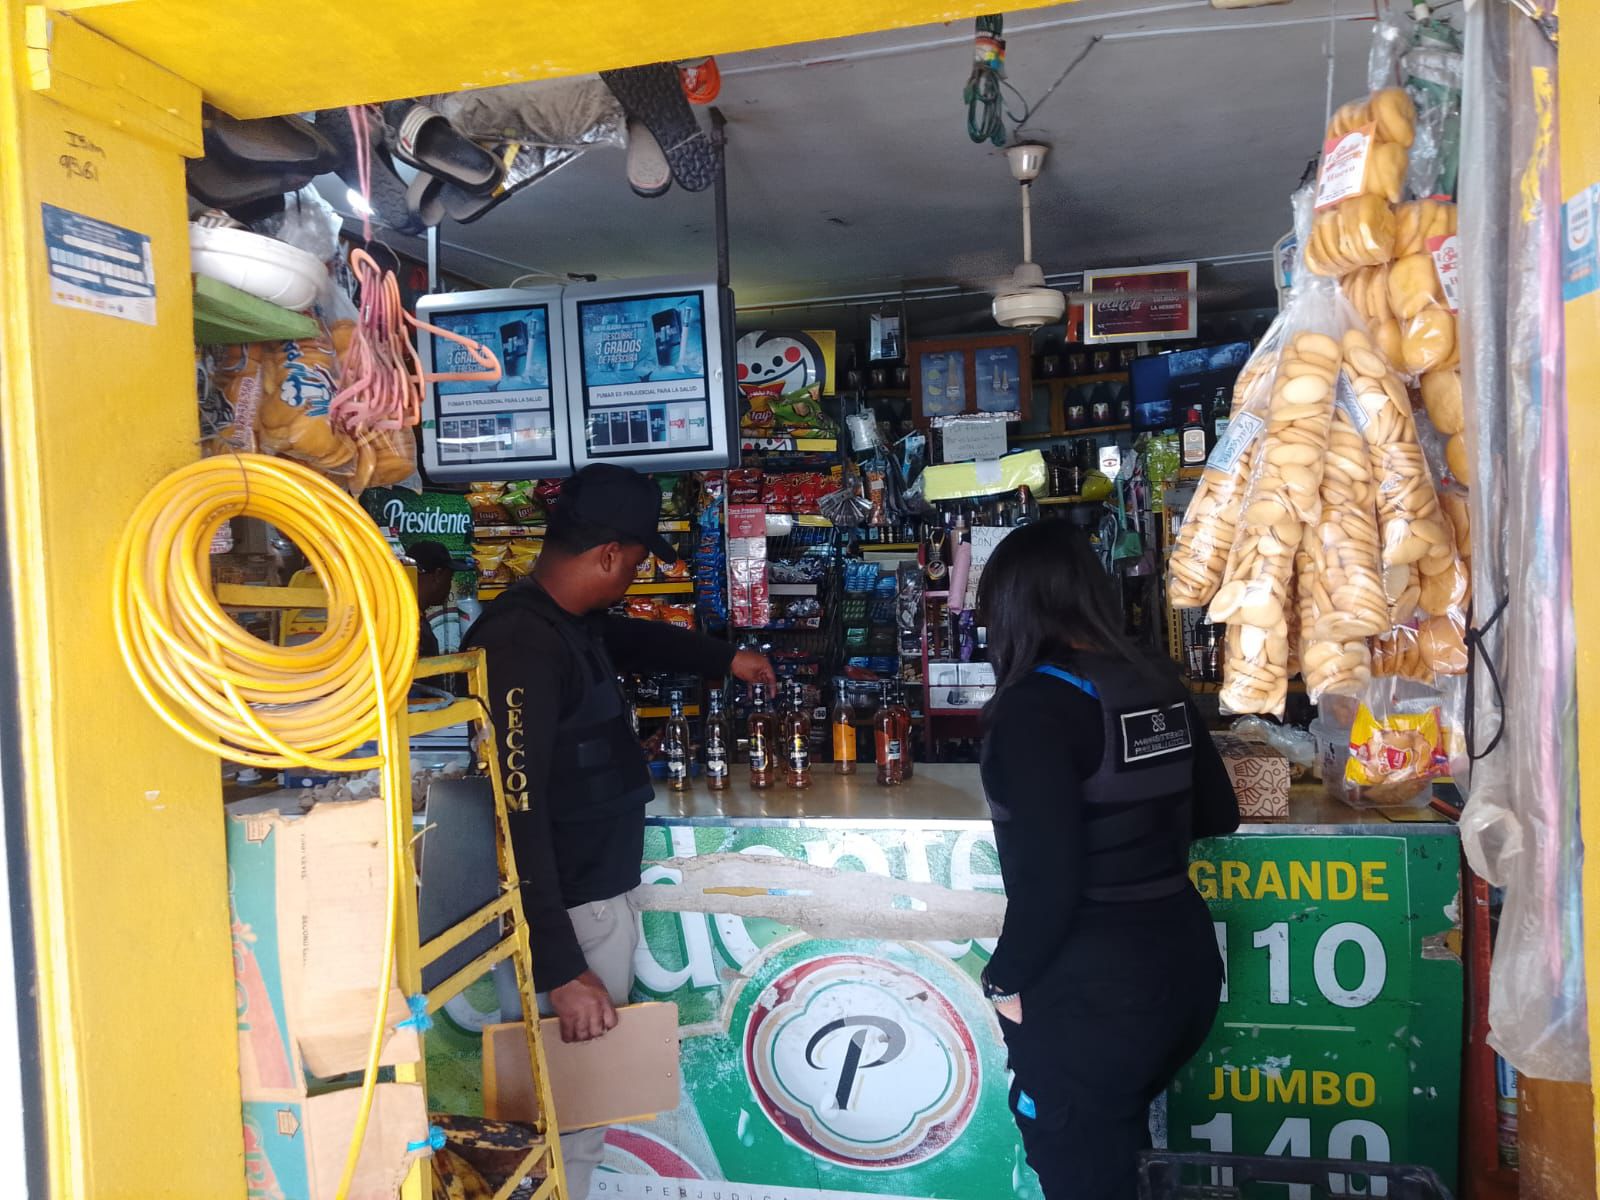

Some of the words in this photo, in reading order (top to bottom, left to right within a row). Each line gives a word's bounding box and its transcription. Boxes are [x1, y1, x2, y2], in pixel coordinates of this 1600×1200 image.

[447, 352, 453, 365] 3
[595, 342, 602, 355] 3
[603, 339, 642, 354] GRADOS
[383, 499, 471, 534] Presidente
[504, 687, 531, 813] CECCOM
[1188, 860, 1390, 902] GRANDE
[1208, 1065, 1377, 1108] JUMBO
[1190, 1112, 1391, 1200] 140
[645, 1185, 789, 1200] PERJUDIC
